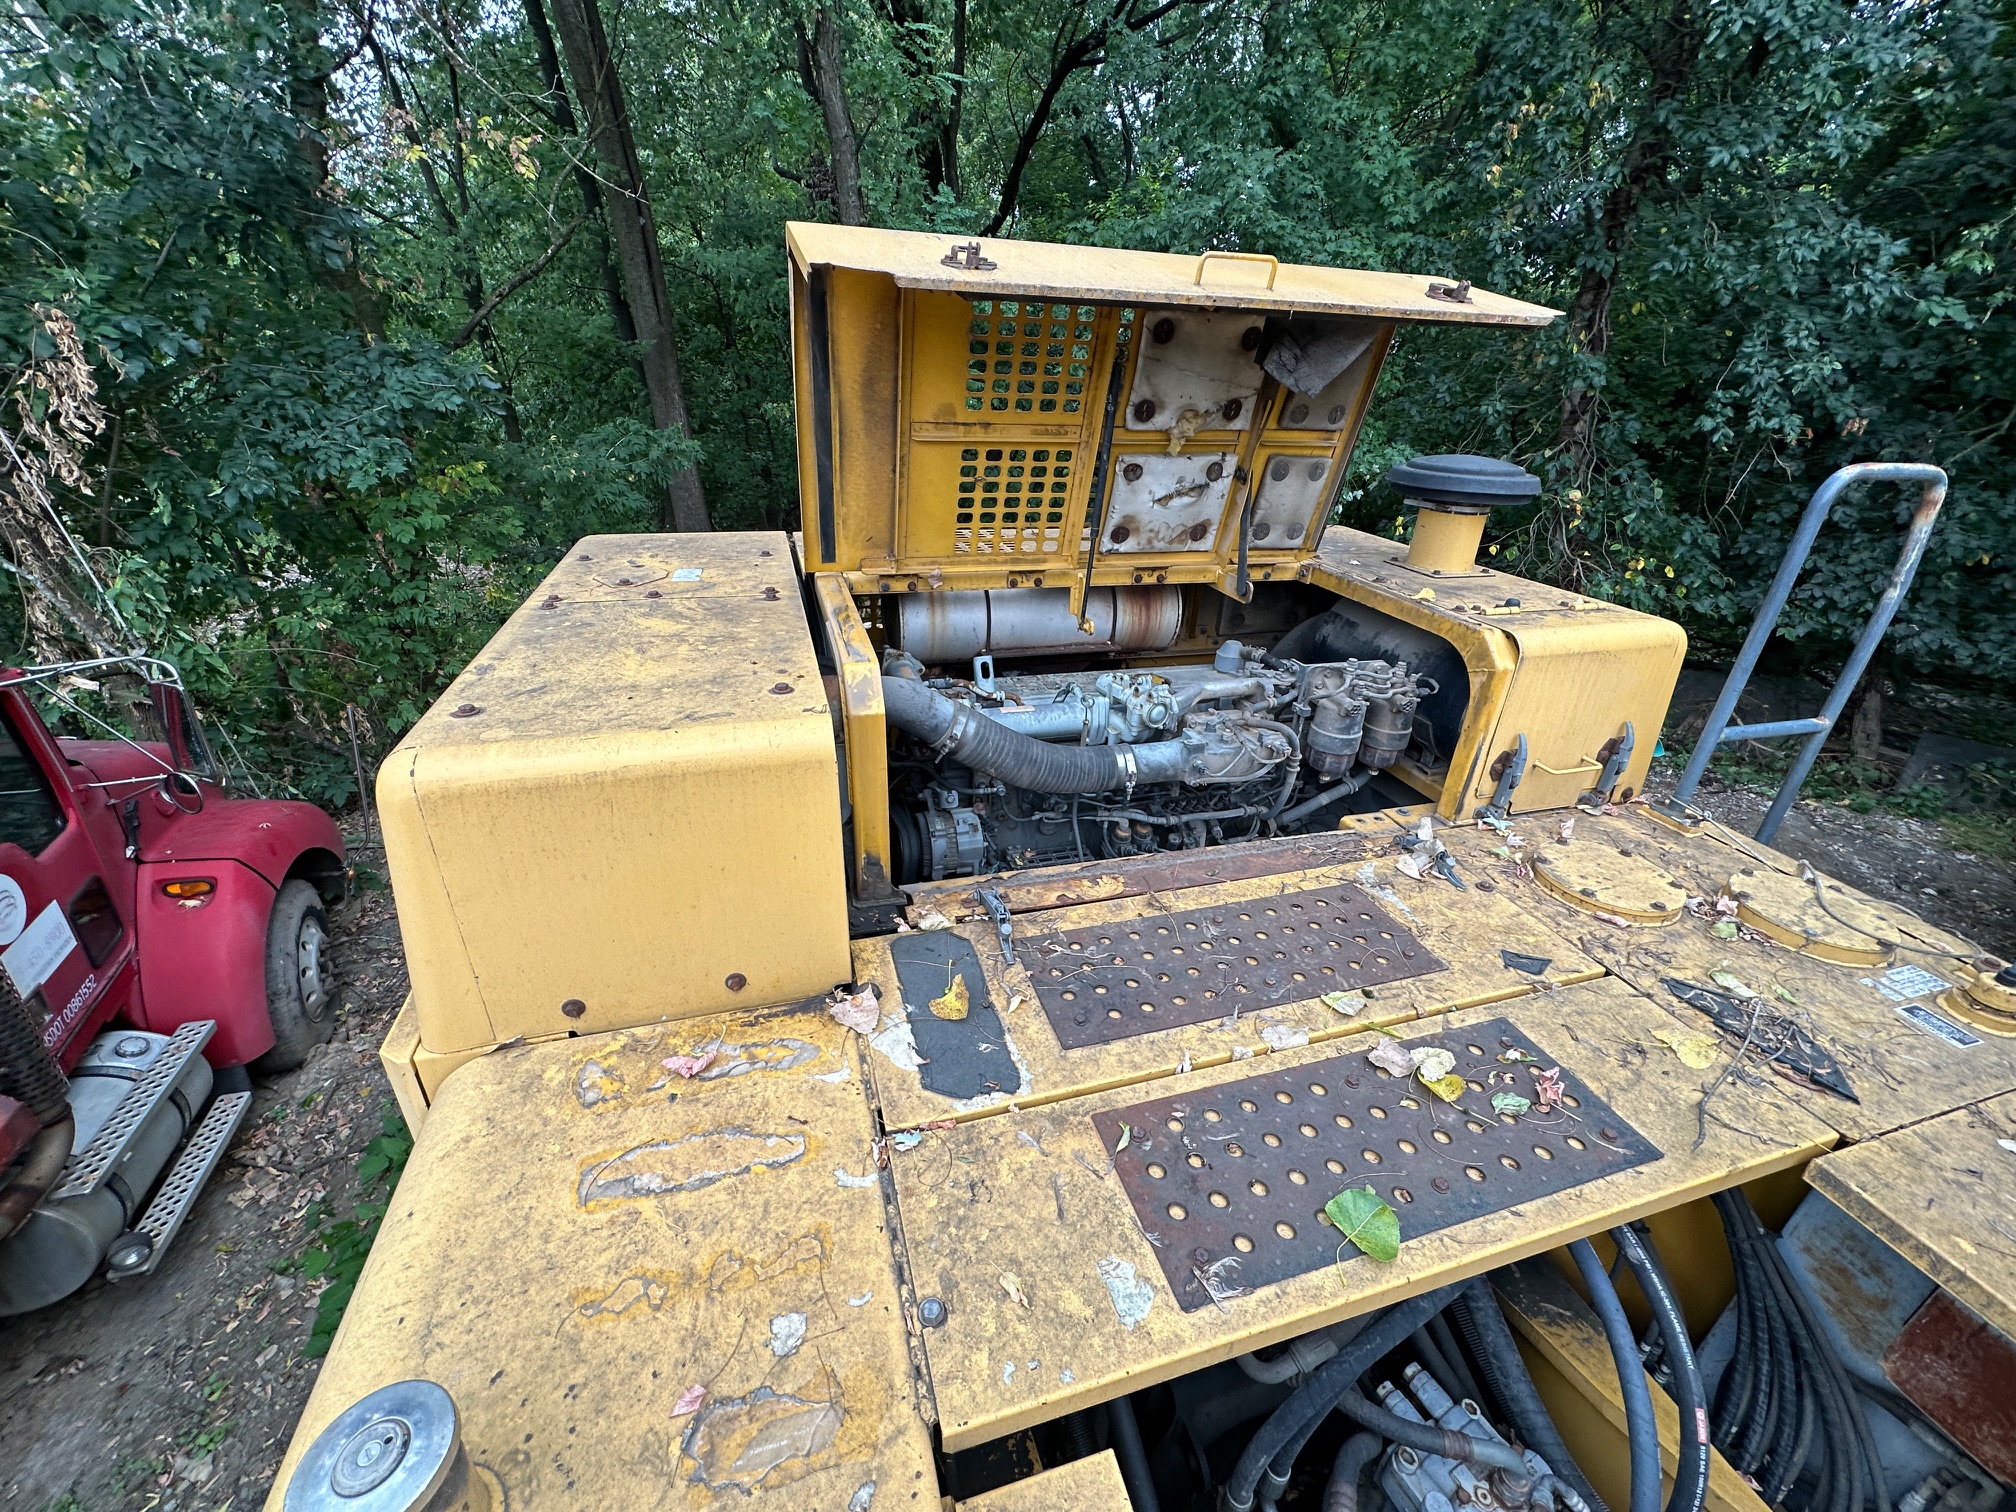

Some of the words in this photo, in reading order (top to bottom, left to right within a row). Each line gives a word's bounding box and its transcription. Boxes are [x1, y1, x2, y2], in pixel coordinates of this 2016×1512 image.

[63, 974, 97, 1022] 00861552
[1669, 1311, 1682, 1333] FLAME
[1678, 1333, 1694, 1370] RESISTANT
